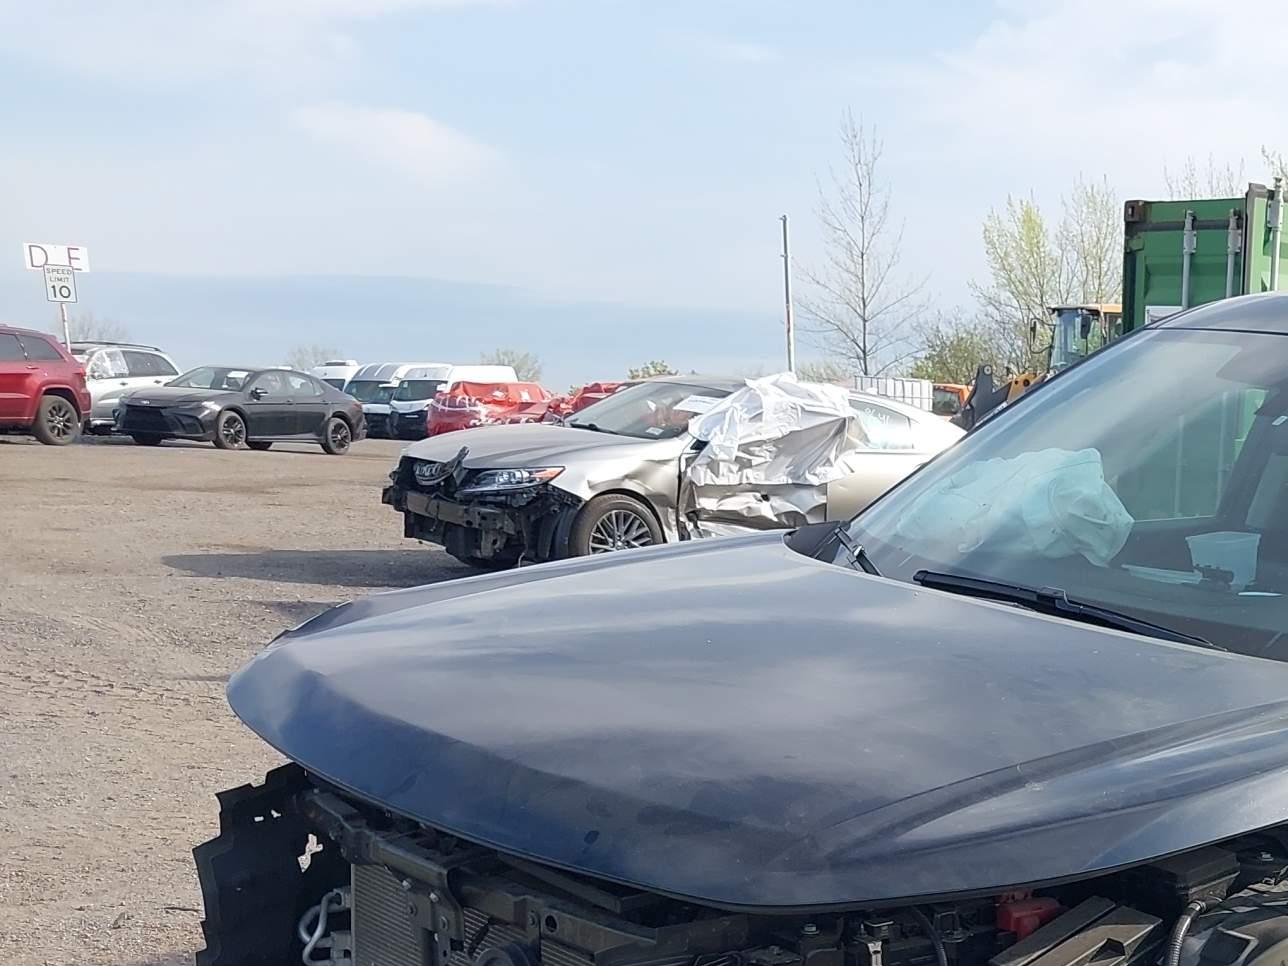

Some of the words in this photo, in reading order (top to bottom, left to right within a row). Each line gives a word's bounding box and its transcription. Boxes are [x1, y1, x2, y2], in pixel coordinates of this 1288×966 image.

[28, 244, 49, 268] D
[67, 247, 83, 271] E
[46, 267, 72, 275] SPEED
[51, 284, 71, 299] 10
